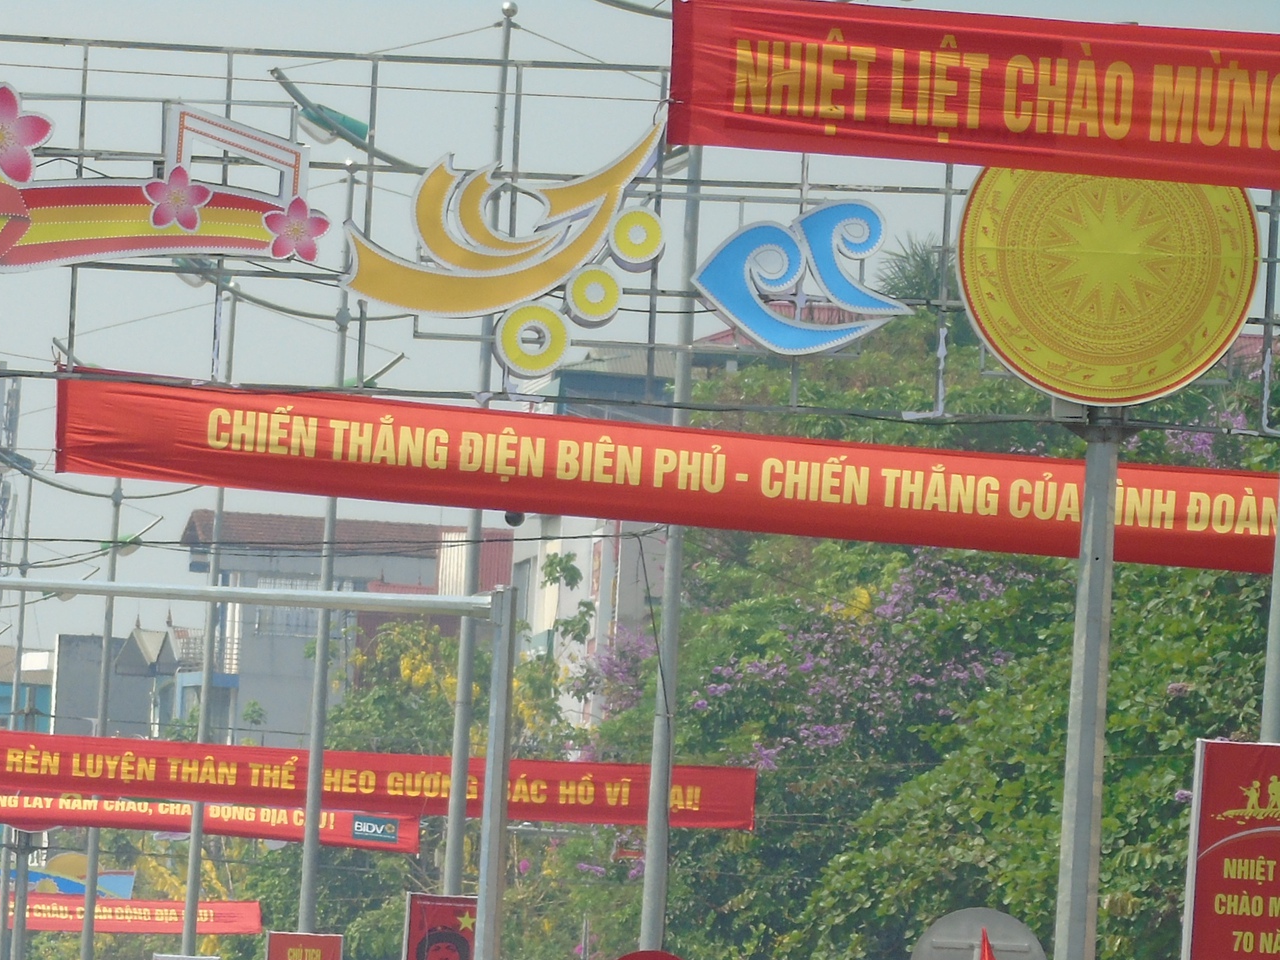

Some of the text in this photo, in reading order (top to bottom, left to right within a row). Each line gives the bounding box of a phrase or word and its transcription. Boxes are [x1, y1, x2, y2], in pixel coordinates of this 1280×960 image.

[732, 28, 877, 136] NHIỆT
[888, 34, 991, 143] LIỆT
[1003, 42, 1134, 140] CHÀO
[207, 405, 317, 457] CHIẾN
[329, 414, 448, 470] THẮNG
[459, 427, 545, 482] ĐIỆN
[556, 435, 642, 486] BIÊN
[653, 444, 726, 494] PHỦ
[761, 455, 870, 505] CHIẾN
[881, 463, 999, 516] THẮNG
[1009, 472, 1080, 523] CỦA
[1114, 478, 1176, 530] ÌNH
[6, 743, 60, 775] RÈN
[71, 750, 156, 785] LUYỆN
[167, 755, 237, 786] THÂN
[249, 755, 297, 789] THỂ
[323, 768, 376, 793] HEO
[507, 773, 548, 803] ÁC
[559, 773, 595, 805] HỒ
[606, 777, 632, 806] VĨ
[669, 784, 702, 813] ẠI!
[260, 808, 288, 826] ĐỊA
[354, 820, 386, 834] BIDV
[1223, 855, 1277, 885] NHIỆT
[1214, 890, 1264, 917] CHÀO
[1232, 931, 1254, 953] 70
